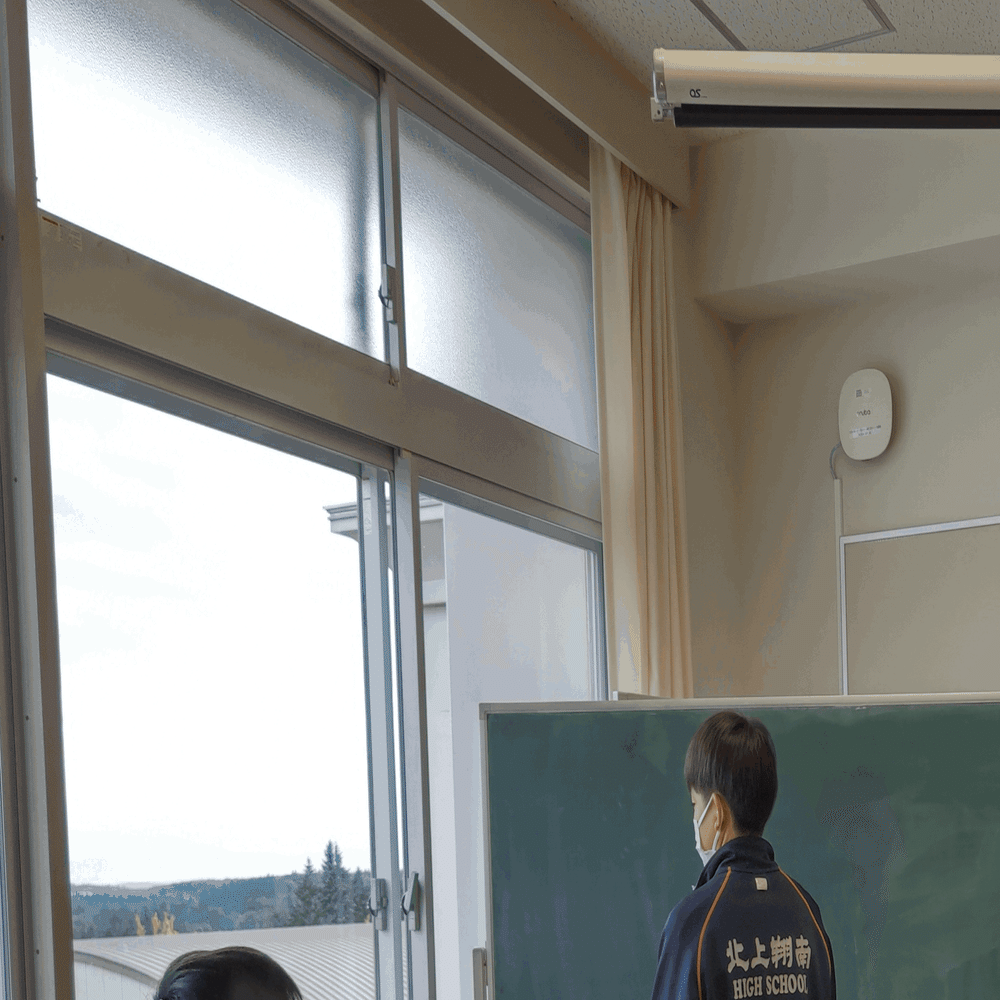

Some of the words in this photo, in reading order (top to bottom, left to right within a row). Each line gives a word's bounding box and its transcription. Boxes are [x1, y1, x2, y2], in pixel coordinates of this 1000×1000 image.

[725, 934, 812, 974] 北上翔南
[732, 975, 763, 1000] HIGH
[765, 973, 809, 995] SCHOOL
